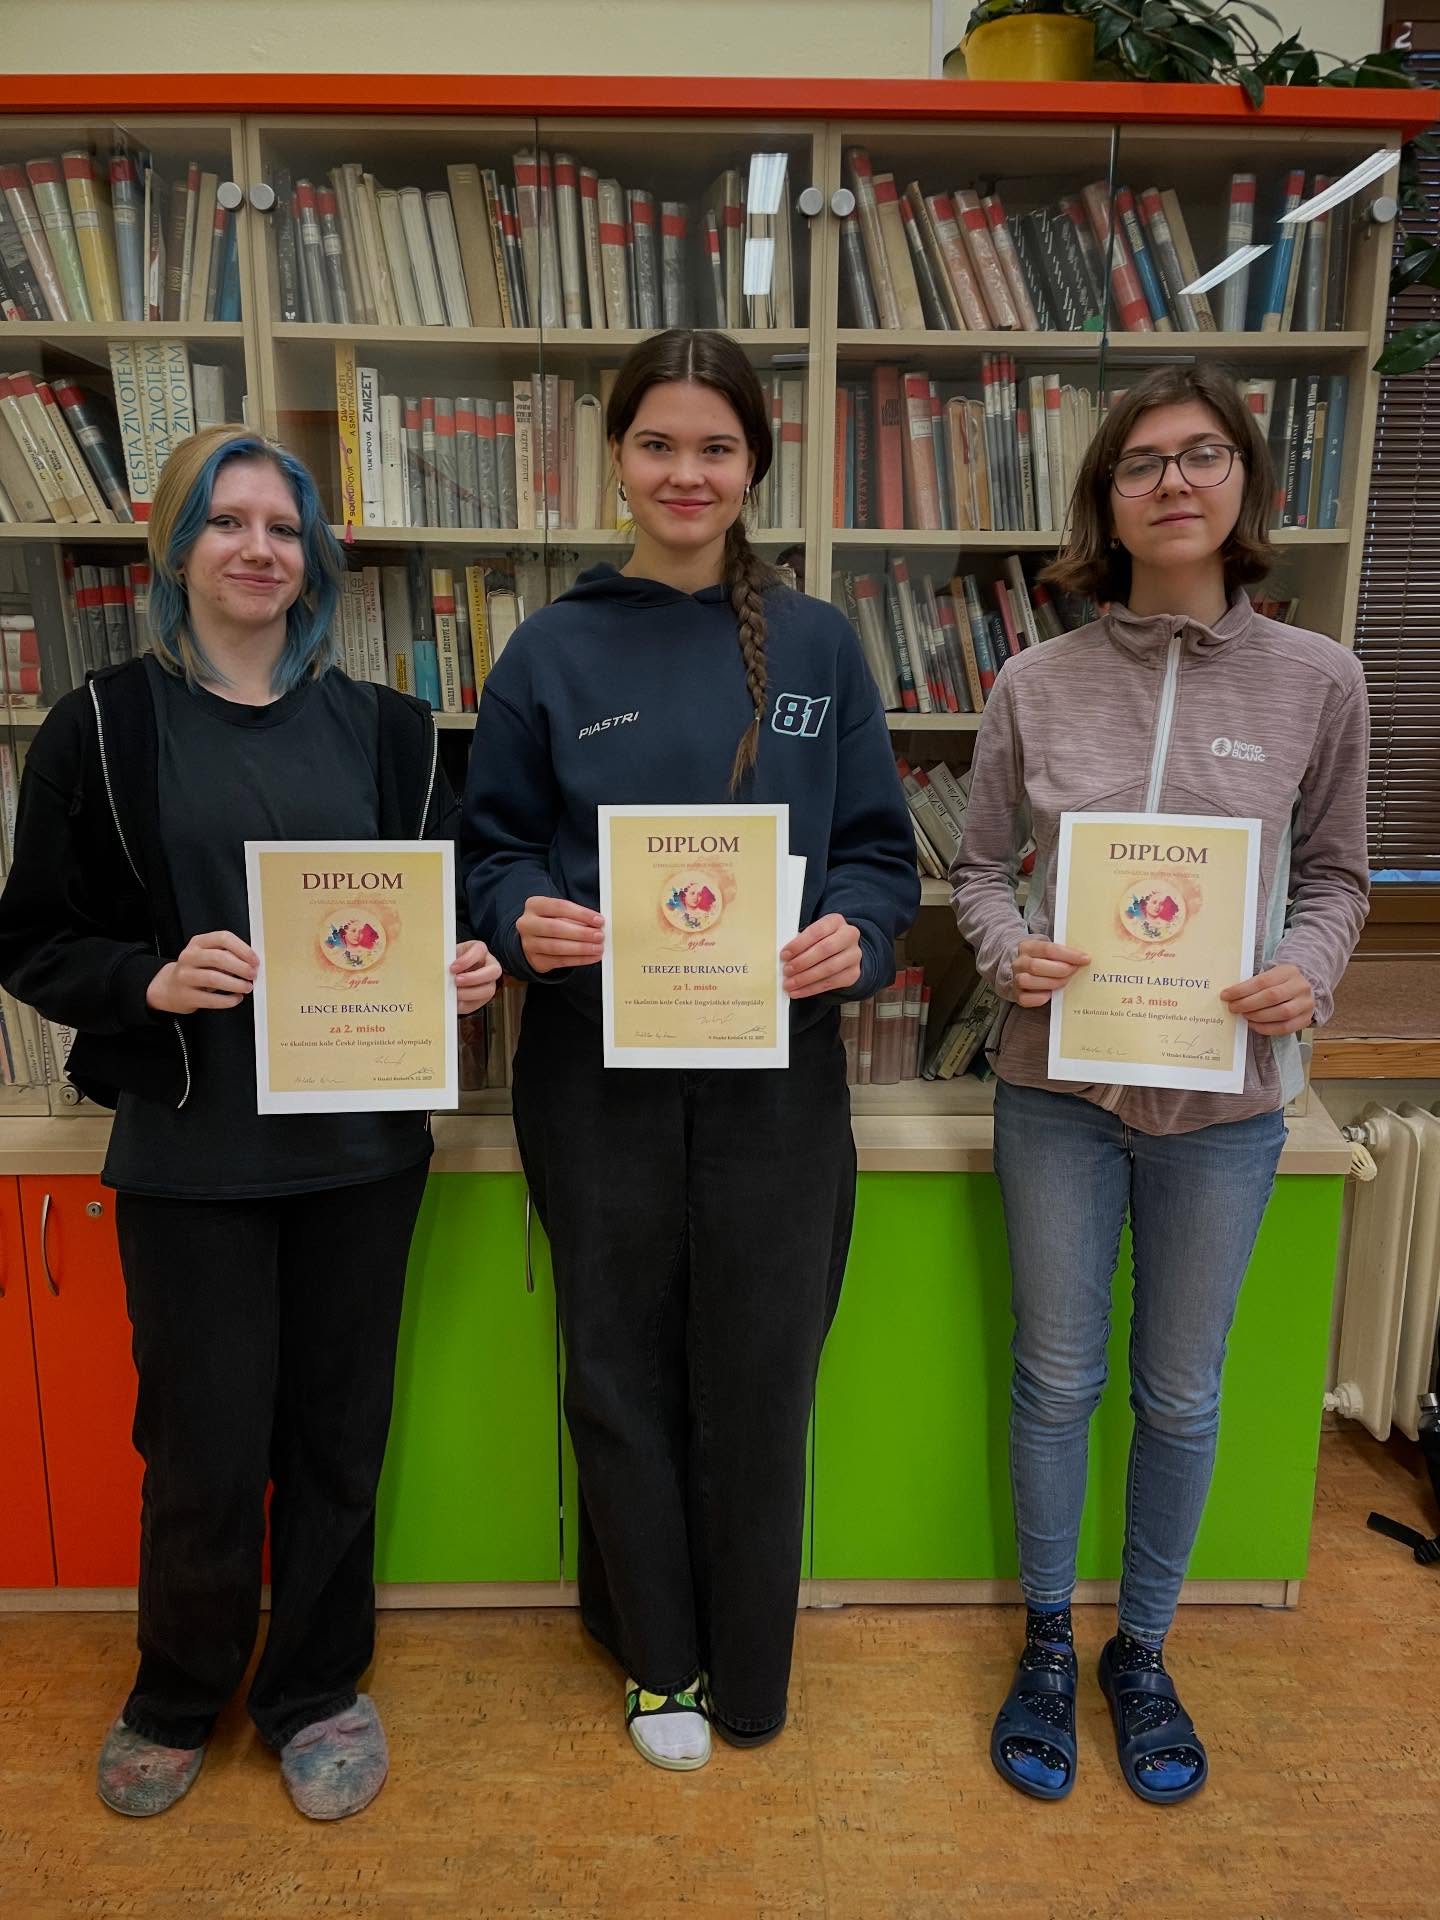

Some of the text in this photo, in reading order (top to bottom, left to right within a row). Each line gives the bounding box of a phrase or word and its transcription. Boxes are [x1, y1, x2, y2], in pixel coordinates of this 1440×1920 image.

[144, 345, 168, 435] ŽIVOTEM
[168, 344, 191, 434] ŽIVOTEM
[360, 372, 372, 423] ZMIZET
[115, 346, 149, 496] CESTA ŽIVOTEM
[771, 692, 831, 737] 81
[578, 711, 640, 740] PIASTRI
[1233, 740, 1262, 753] NORD
[1232, 749, 1266, 761] BLANC
[647, 836, 740, 853] DIPLOM
[1109, 843, 1209, 864] DIPLOM
[302, 872, 404, 890] DIPLOM
[641, 964, 749, 974] TEREZE BURIANOVÉ
[685, 983, 691, 991] 1.
[1093, 973, 1210, 989] PATRICII LABUTOVÉ
[674, 998, 693, 1006] České
[1121, 996, 1134, 1004] za
[1136, 996, 1146, 1005] 3.
[300, 1002, 413, 1014] LENCE BERÁNKOVÉ
[1126, 1007, 1147, 1018] České
[330, 1025, 341, 1033] za
[344, 1024, 353, 1033] 2.
[336, 1039, 355, 1047] České
